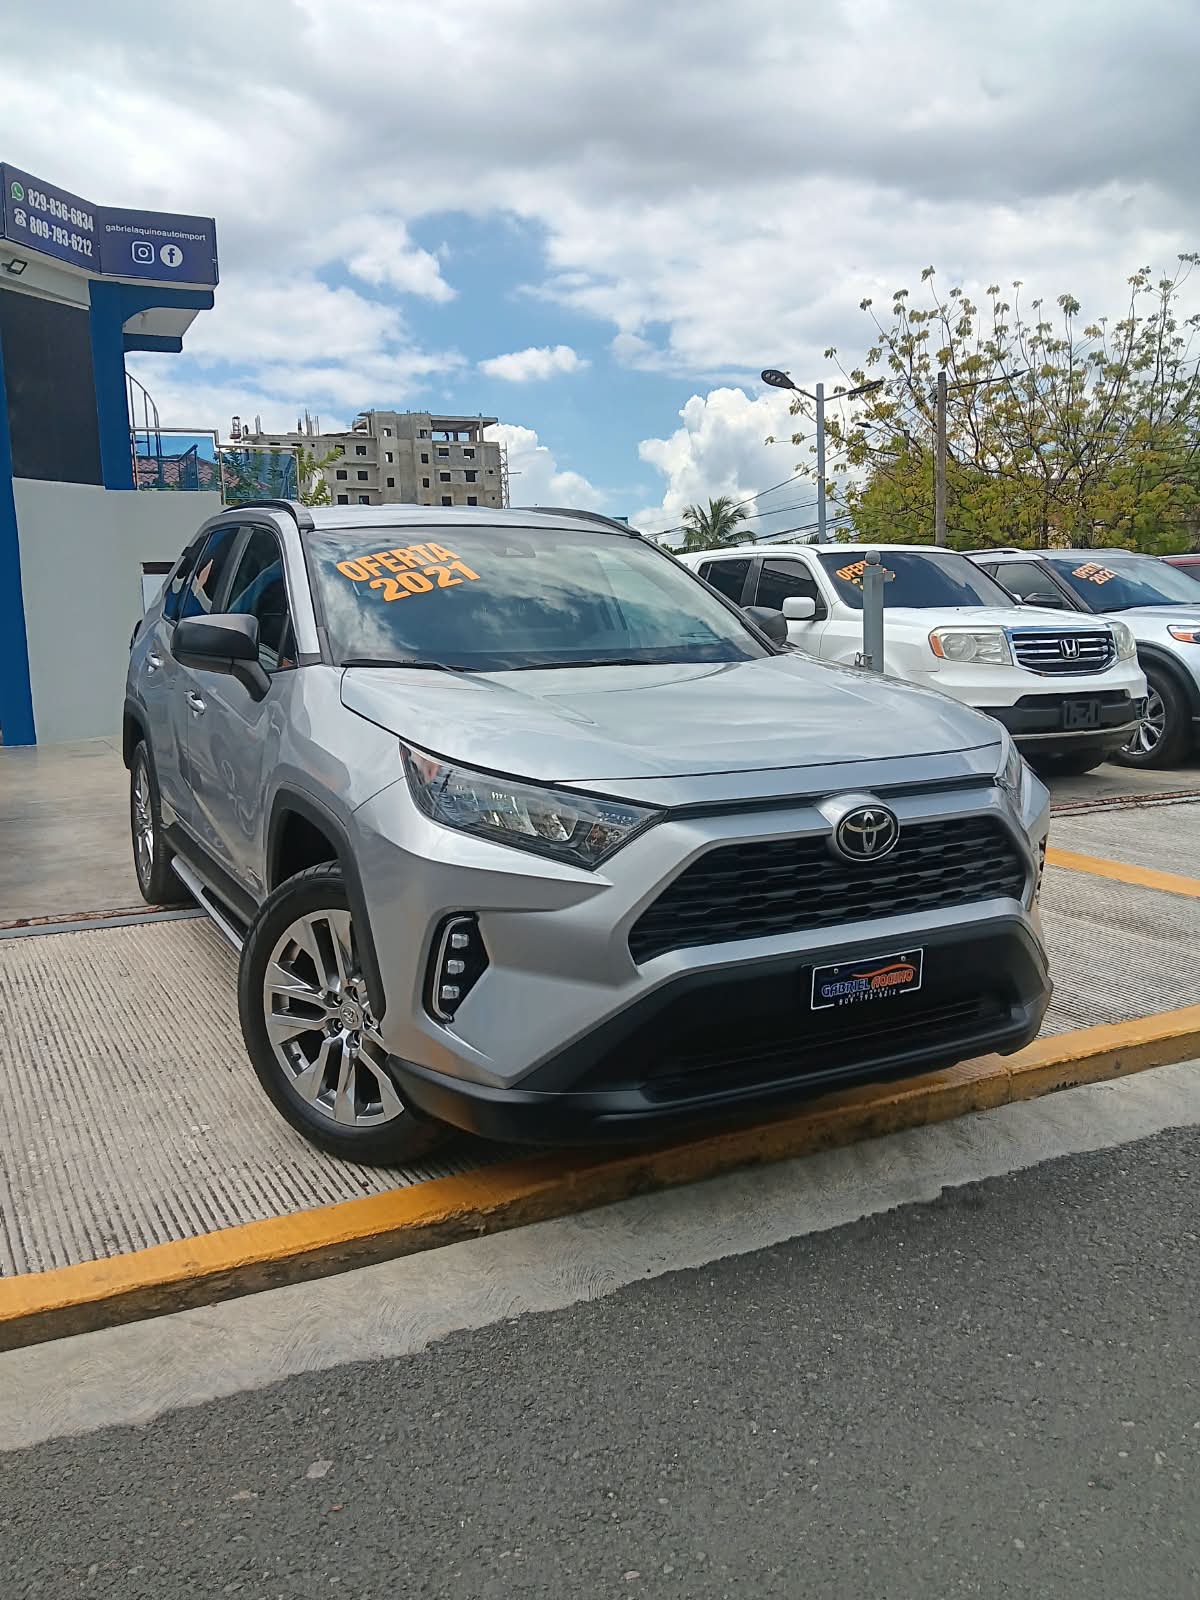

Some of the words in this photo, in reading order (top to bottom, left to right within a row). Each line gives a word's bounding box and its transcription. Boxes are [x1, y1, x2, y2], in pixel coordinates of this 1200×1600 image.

[28, 188, 94, 232] 829-836-6834
[30, 215, 92, 256] 809-793-6212
[105, 224, 206, 241] gabrielaquinoautoimport
[336, 542, 462, 582] OFERTA
[369, 560, 481, 602] 2021
[821, 978, 871, 998] GABRIEL
